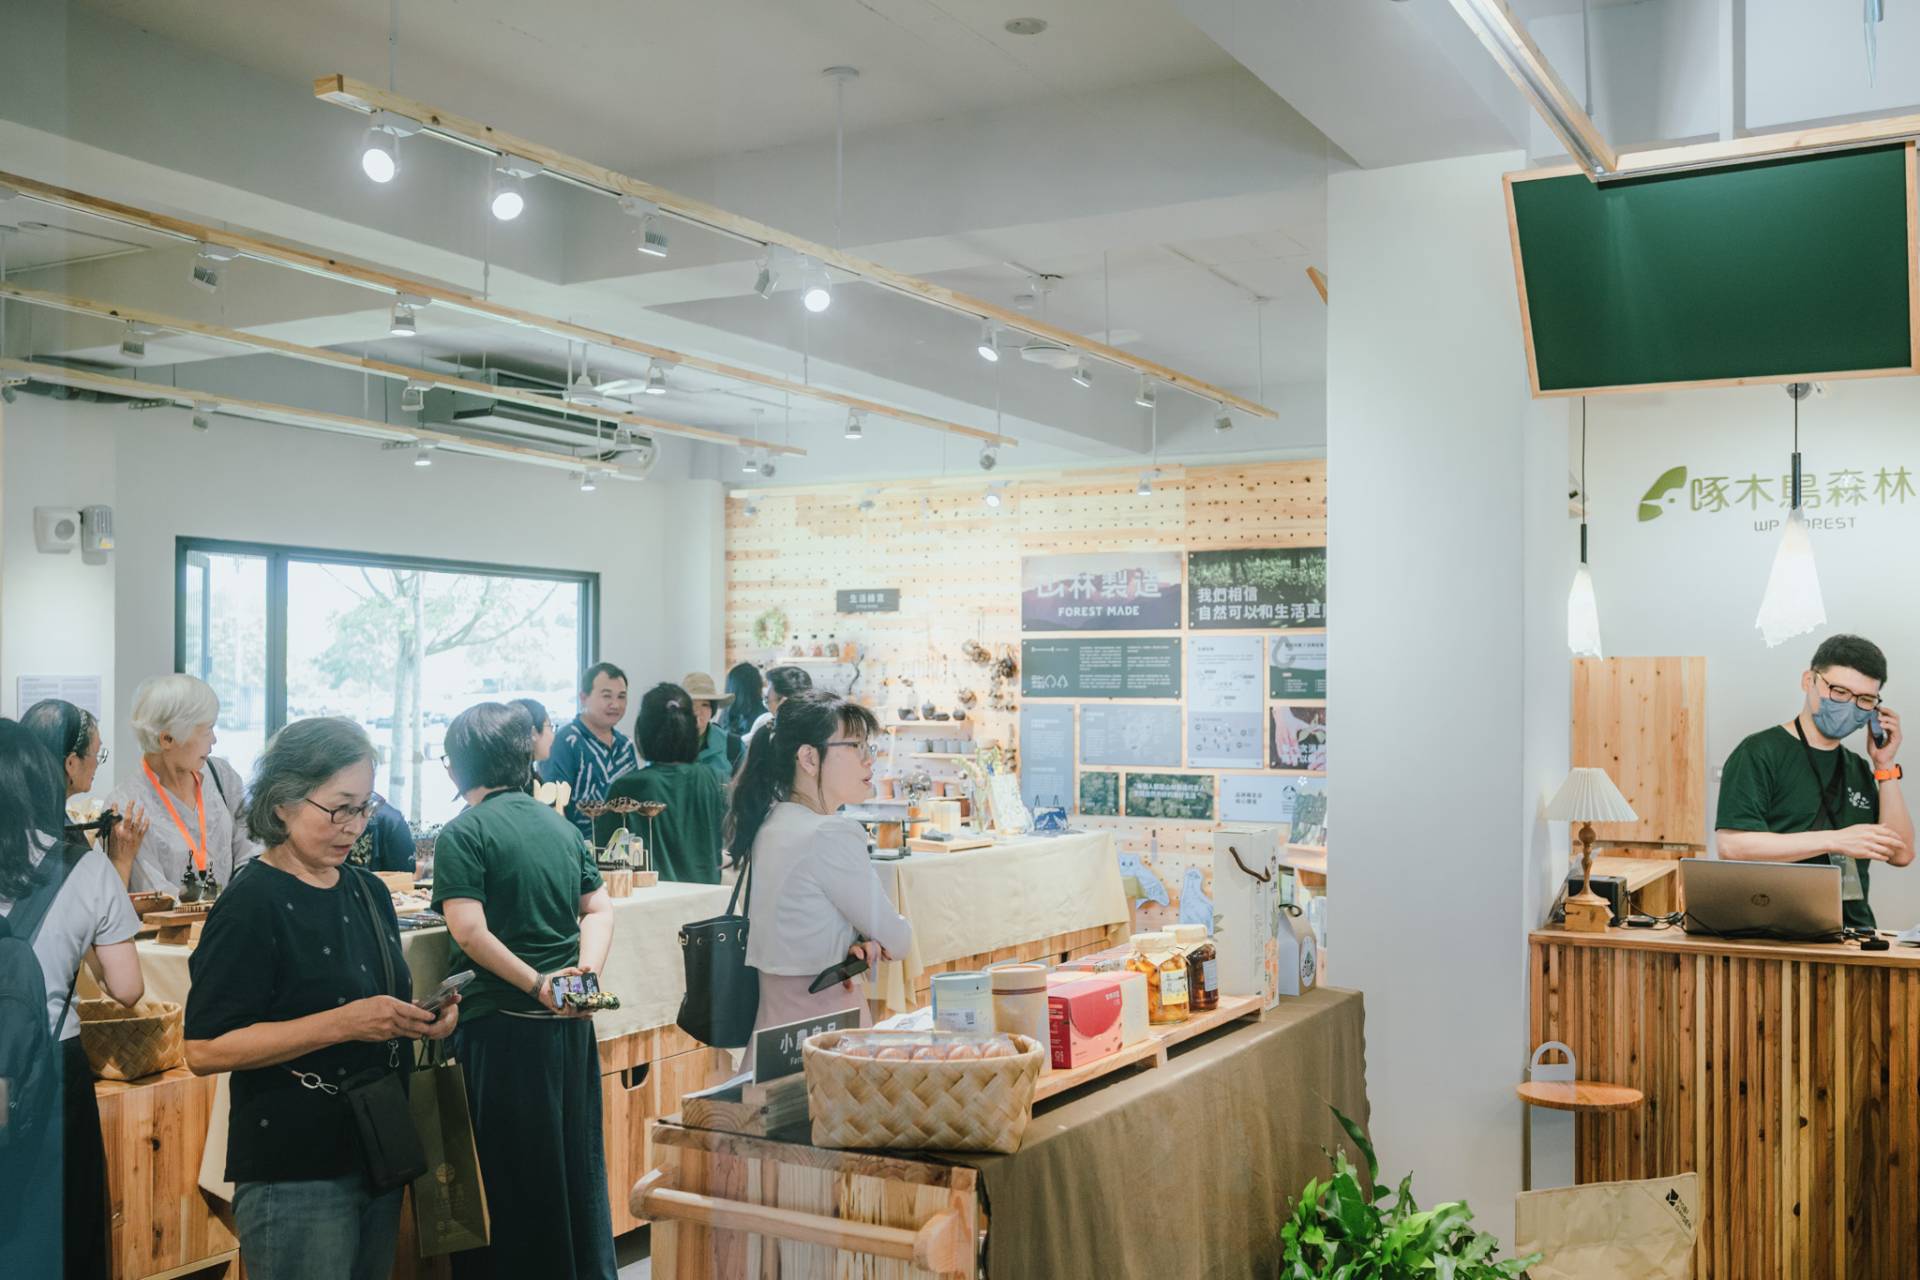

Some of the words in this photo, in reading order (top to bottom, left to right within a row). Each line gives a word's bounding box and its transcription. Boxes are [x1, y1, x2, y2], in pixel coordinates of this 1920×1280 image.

[1691, 466, 1917, 513] 啄木鳥森林
[1754, 520, 1779, 532] WP
[1804, 516, 1857, 530] OREST
[1037, 570, 1162, 599] 山林製造
[1198, 586, 1258, 603] 我們相信
[1058, 606, 1103, 617] FOREST
[1107, 605, 1140, 616] MADE
